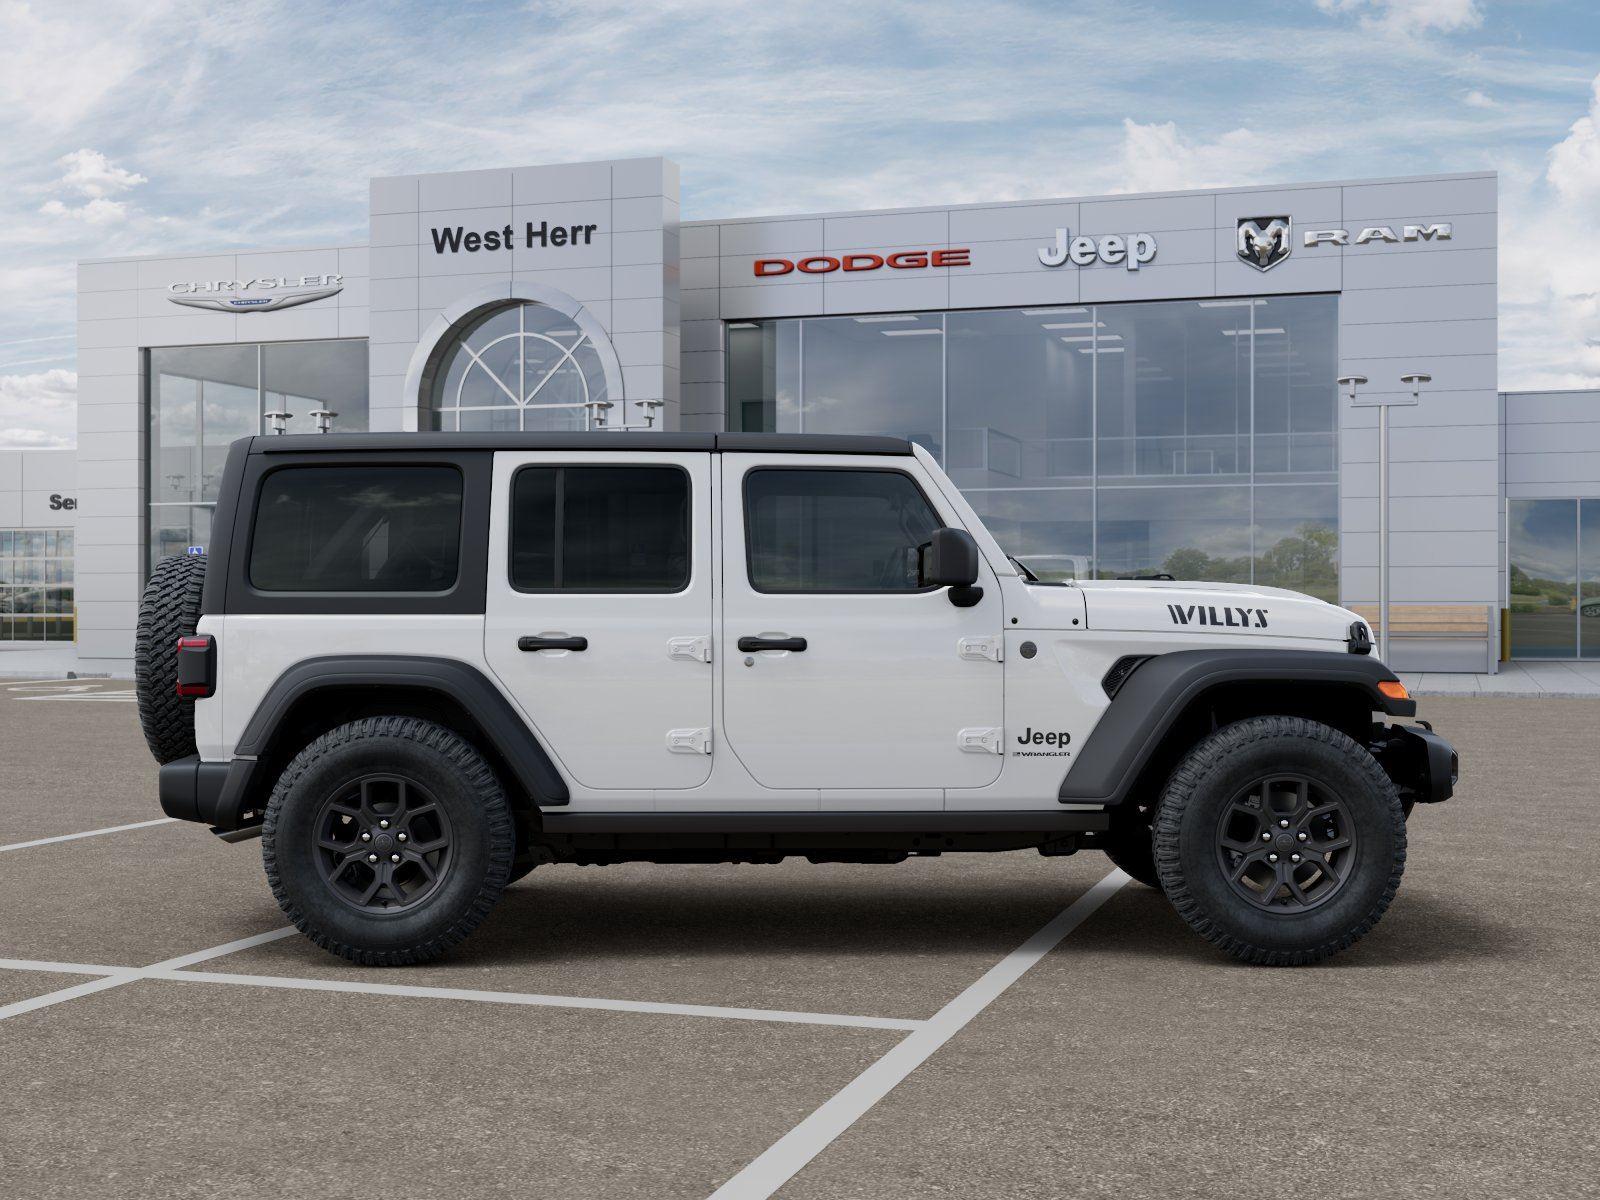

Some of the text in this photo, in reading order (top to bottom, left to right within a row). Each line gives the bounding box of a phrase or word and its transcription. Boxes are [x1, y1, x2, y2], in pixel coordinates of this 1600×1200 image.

[431, 221, 597, 254] West Herr
[1304, 223, 1452, 248] RAM
[1038, 227, 1157, 271] Jeep
[754, 249, 971, 276] DODGE
[168, 273, 344, 293] CHRYSLER
[49, 494, 77, 510] Se
[1167, 604, 1268, 628] WILLYS
[1017, 727, 1071, 748] Jeep
